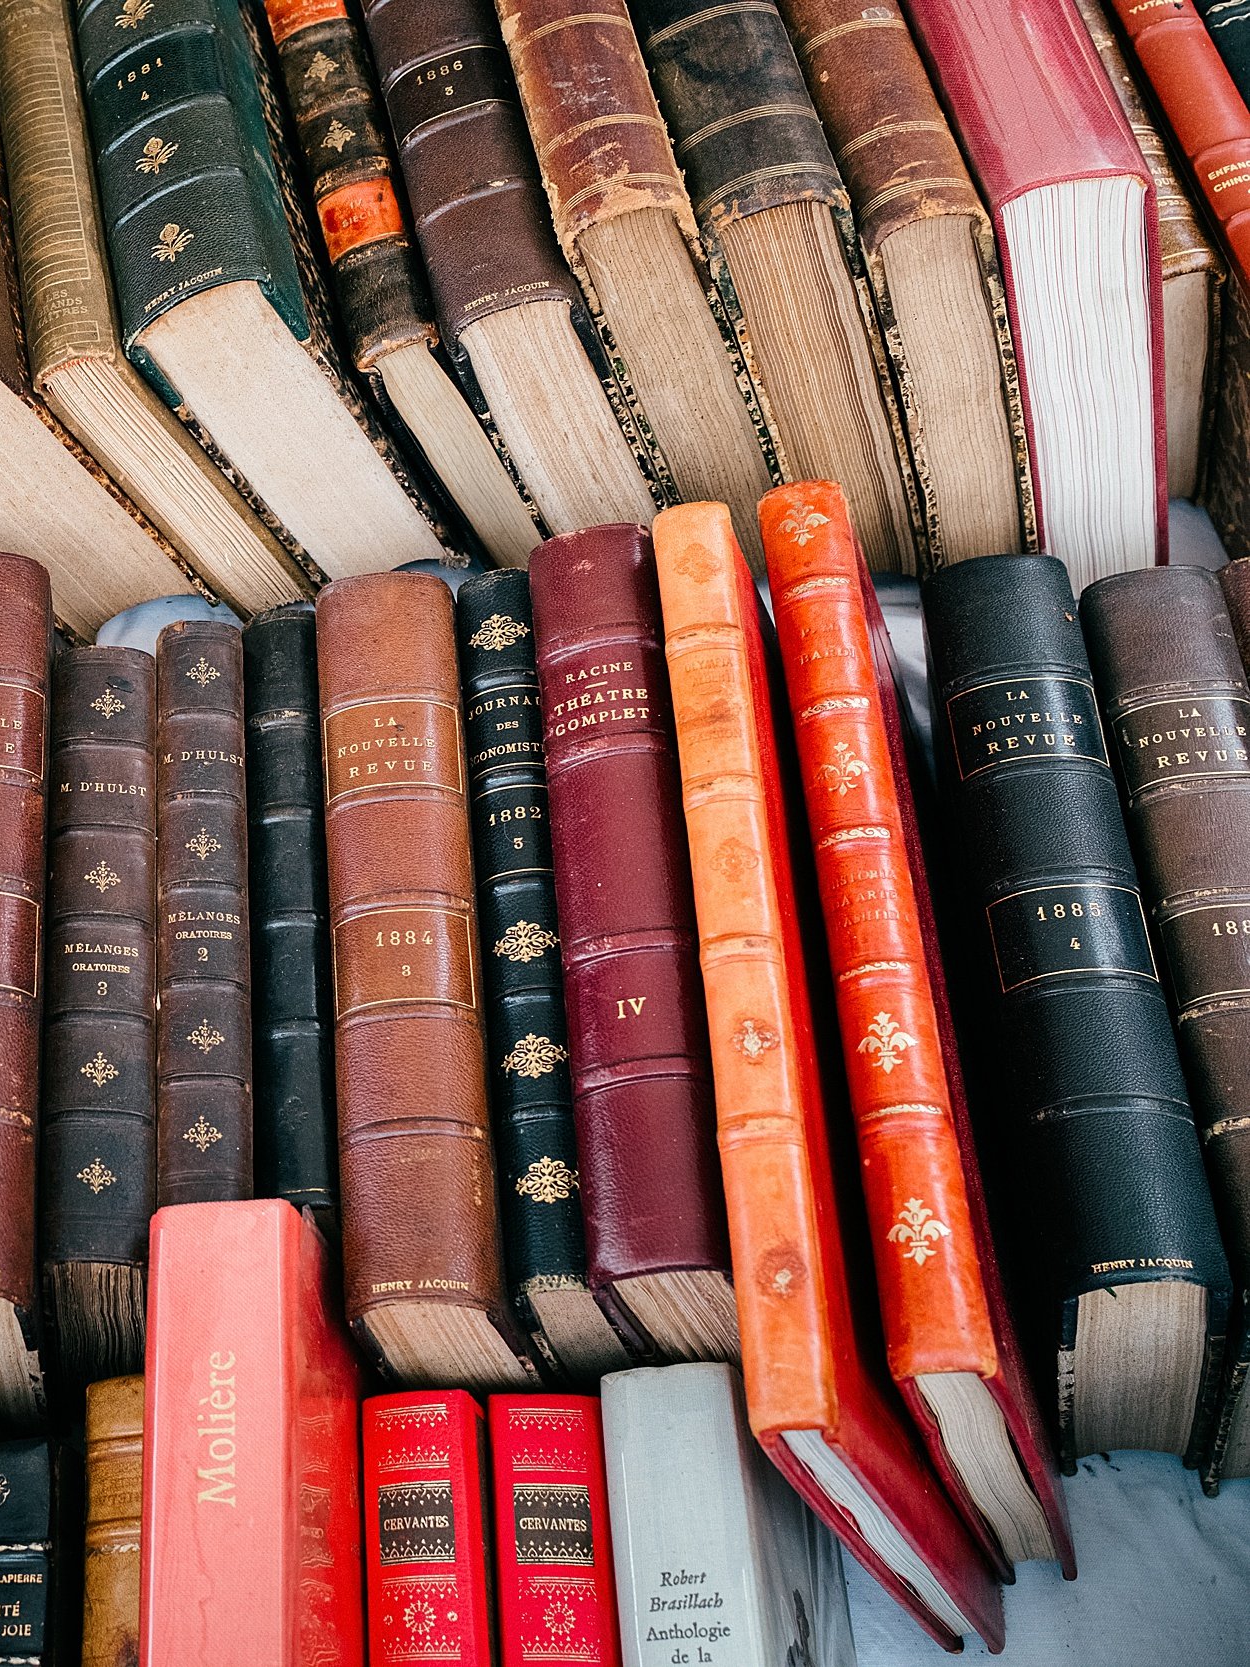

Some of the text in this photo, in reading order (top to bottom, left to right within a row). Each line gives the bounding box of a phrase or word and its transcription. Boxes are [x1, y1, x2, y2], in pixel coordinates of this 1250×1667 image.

[117, 57, 163, 90] 1881
[417, 60, 463, 86] 1886
[141, 91, 150, 101] 4
[143, 267, 223, 313] HENRY JACQUIN
[464, 281, 550, 312] HENRY JACQUIN
[565, 662, 634, 683] RACINE
[553, 686, 648, 717] THÉATRE
[1006, 691, 1029, 700] LA
[1178, 708, 1202, 719] LA
[374, 717, 398, 728] LA
[496, 721, 519, 731] DES
[554, 708, 650, 737] COMPLET
[972, 713, 1083, 735] NOUVELLE
[987, 734, 1076, 755] REVUE
[1138, 726, 1247, 749] NOUVELLE
[338, 737, 436, 758] NOUVELLE
[471, 742, 544, 766] CONOMIST
[163, 750, 243, 767] M. D'HULST
[1156, 749, 1249, 769] REVUE
[349, 760, 433, 778] REVUE
[61, 782, 147, 797] M. D'HULST
[489, 806, 541, 826] 1882
[1036, 902, 1101, 921] 1885
[175, 930, 232, 940] ORATOIRES
[375, 930, 433, 947] 1884
[1070, 937, 1081, 950] 4
[64, 943, 139, 957] MÉLANGES
[197, 947, 209, 961] 2
[72, 963, 130, 974] ORATOIRES
[401, 965, 411, 977] 3
[97, 981, 108, 996] 3
[616, 997, 646, 1020] IV
[1091, 1258, 1194, 1273] HENRY JACQUIN
[371, 1279, 469, 1293] HENRY JACQUIN
[196, 1348, 237, 1508] Molière
[383, 1515, 449, 1531] CERVANTES
[519, 1516, 587, 1532] CERVANTES
[660, 1571, 707, 1587] Robert
[650, 1595, 723, 1612] Brasillach
[1, 1624, 32, 1637] JOIE
[646, 1622, 731, 1642] Anthologie
[671, 1647, 712, 1665] de la
